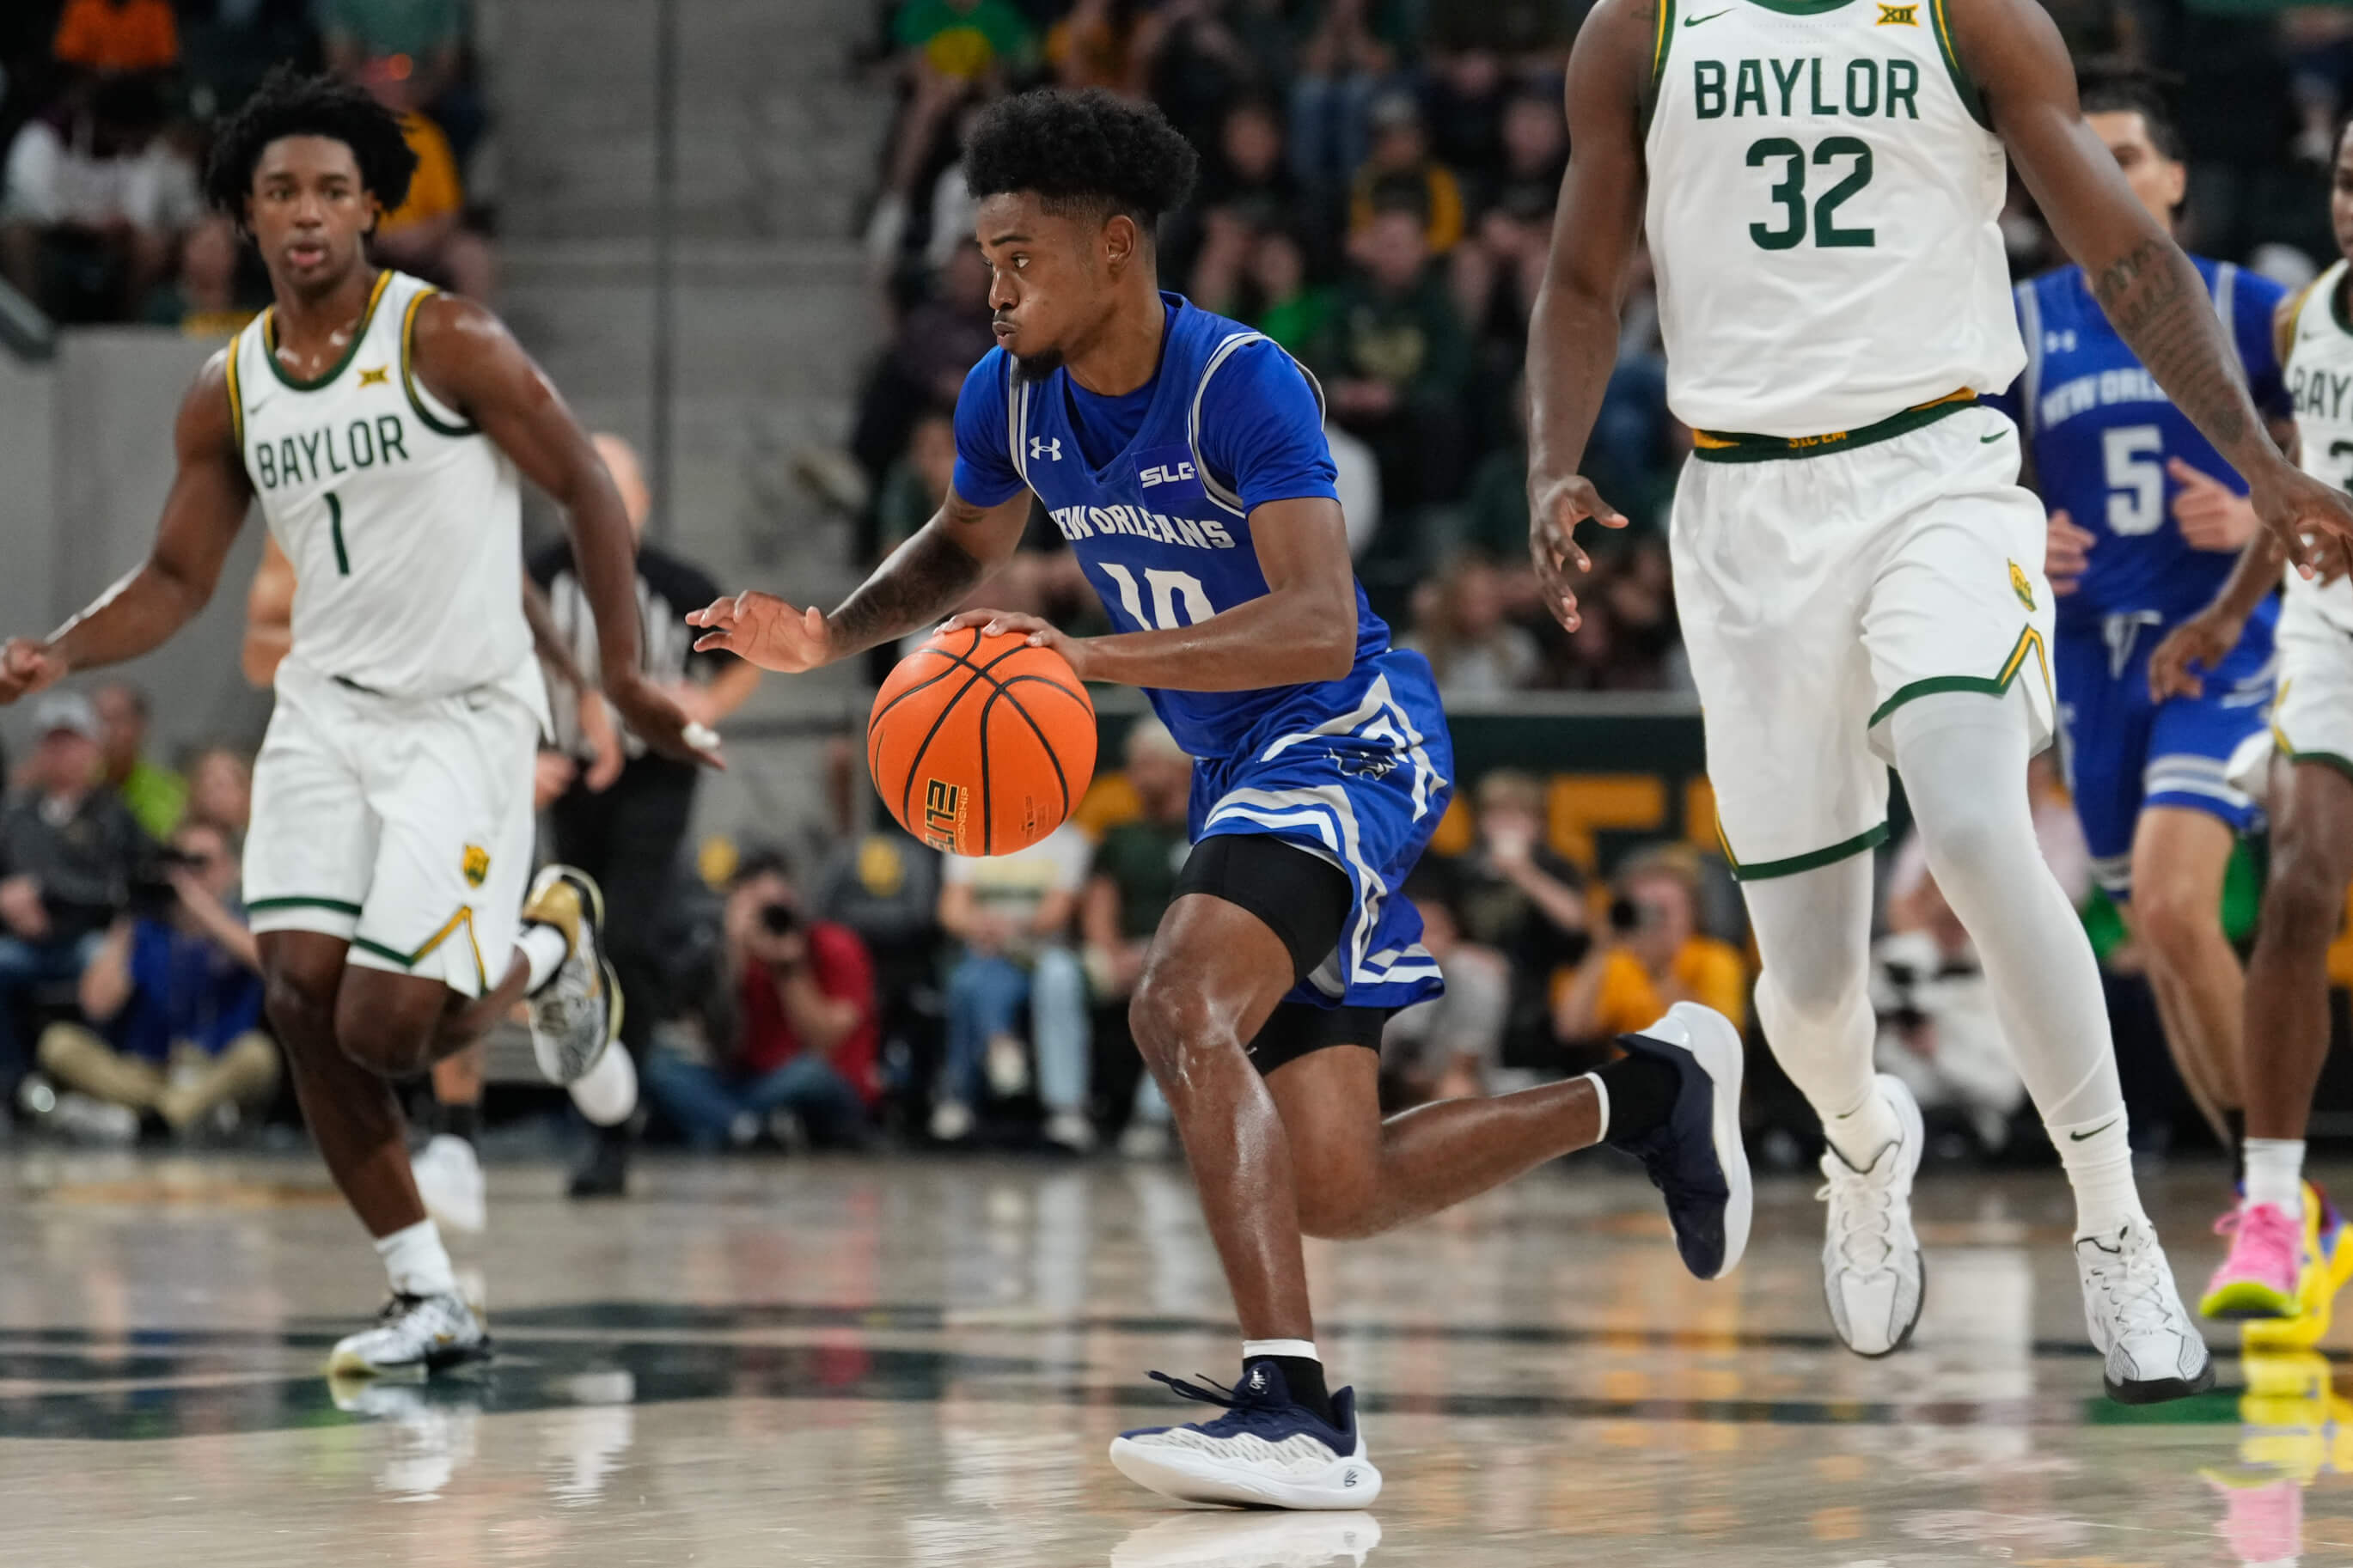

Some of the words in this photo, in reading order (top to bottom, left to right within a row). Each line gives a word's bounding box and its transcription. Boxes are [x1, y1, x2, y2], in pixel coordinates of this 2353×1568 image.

[1694, 58, 1920, 120] BAYLOR
[1745, 136, 1876, 251] 32
[2294, 365, 2353, 419] BAY
[257, 414, 410, 490] BAYLOR
[2102, 426, 2164, 536] 5
[323, 491, 350, 577] 1
[1089, 504, 1236, 549] ORLEANS
